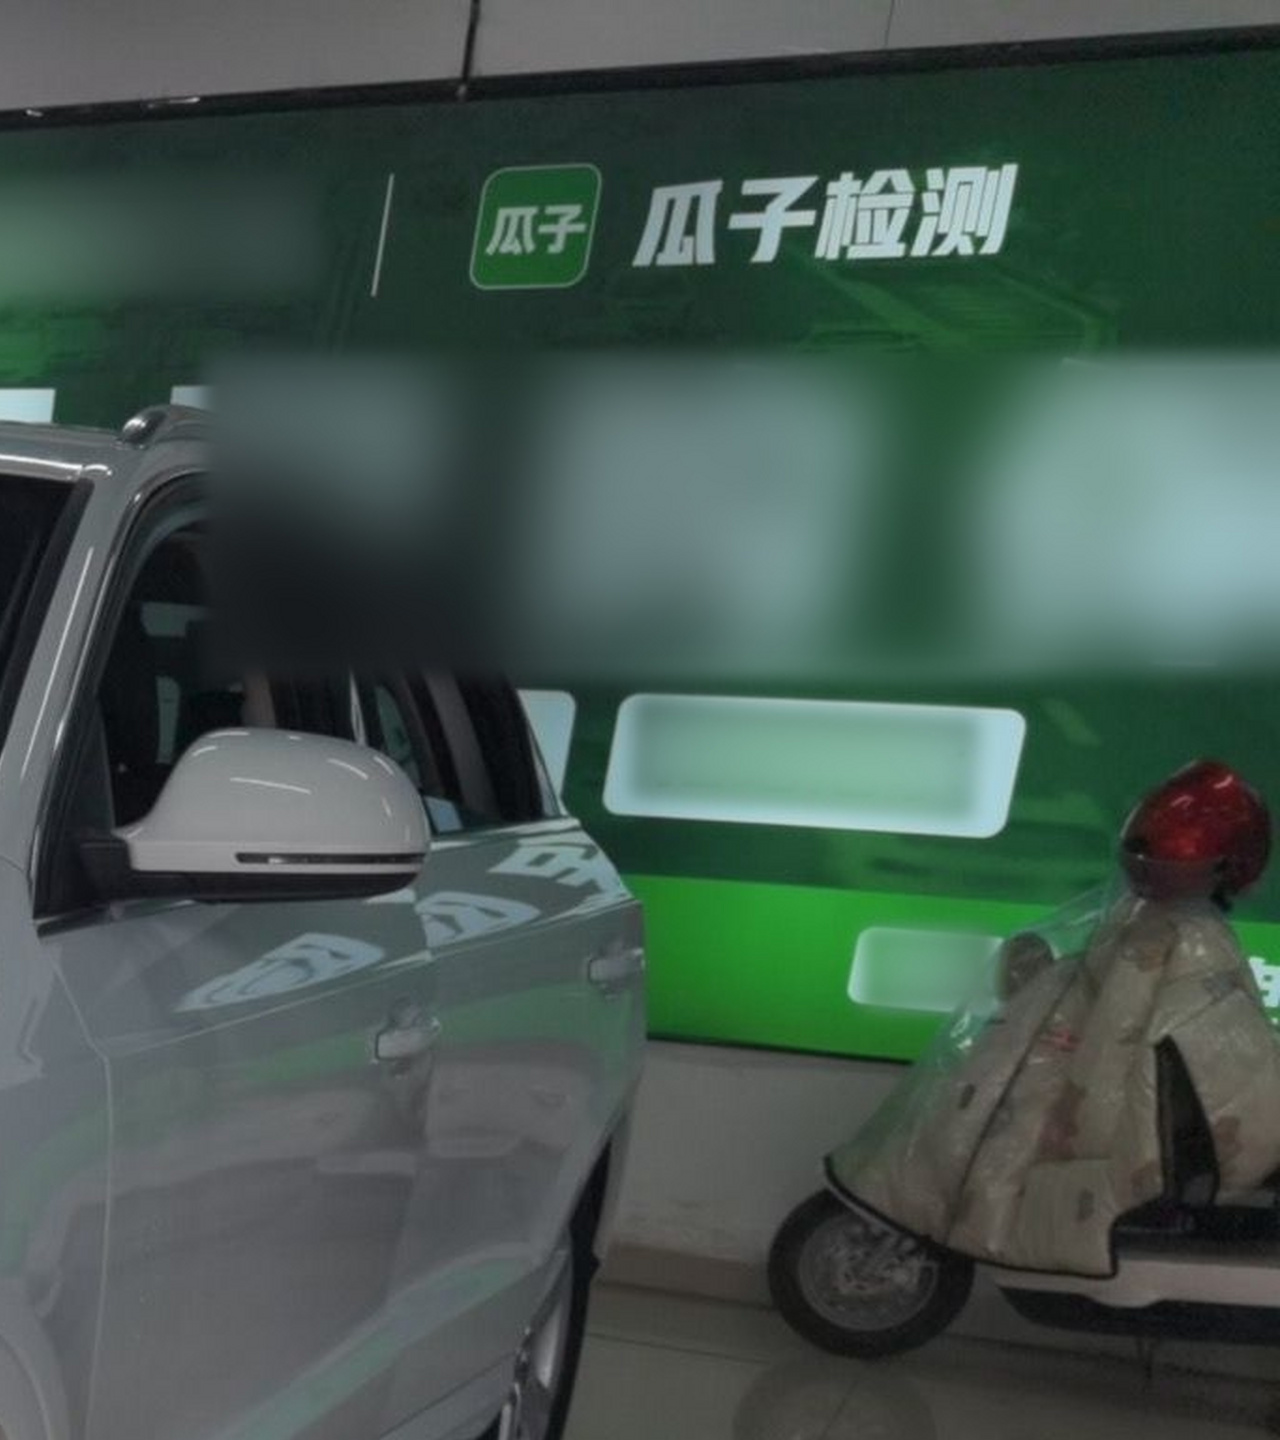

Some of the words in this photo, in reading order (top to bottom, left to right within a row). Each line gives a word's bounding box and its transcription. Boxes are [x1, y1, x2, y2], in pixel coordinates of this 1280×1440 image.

[485, 204, 586, 256] 瓜子
[632, 163, 1019, 267] 瓜子检测
